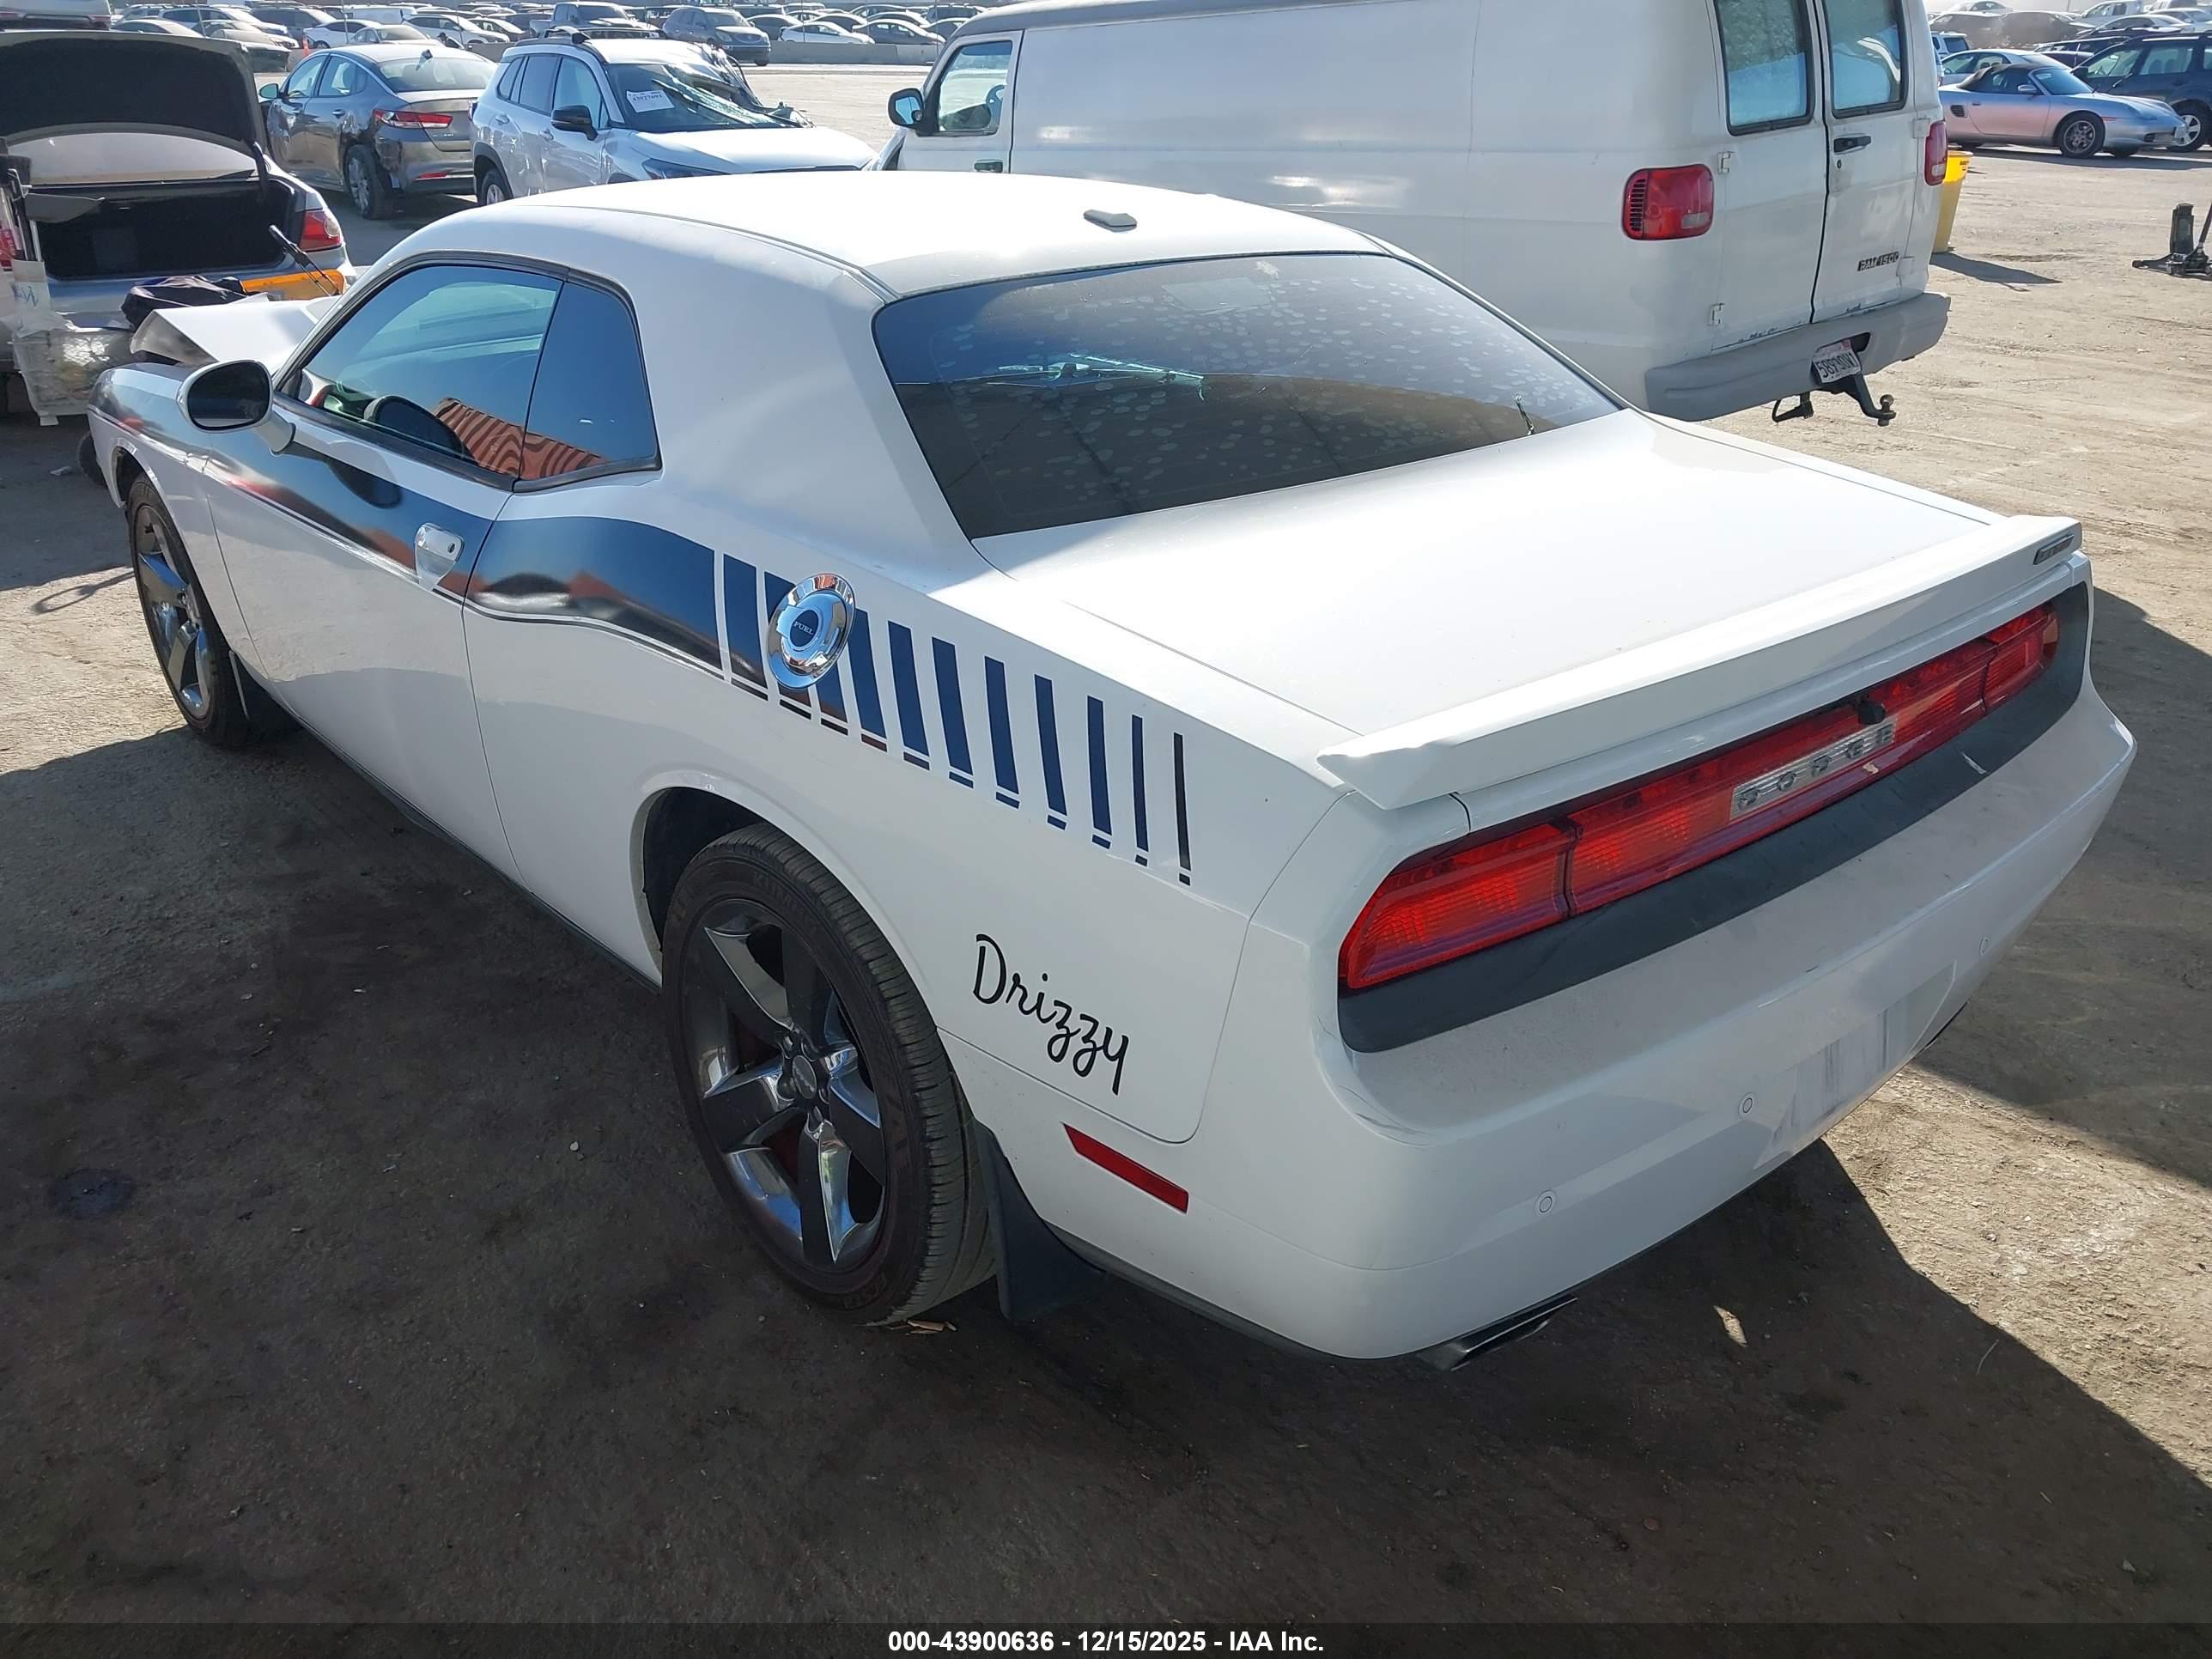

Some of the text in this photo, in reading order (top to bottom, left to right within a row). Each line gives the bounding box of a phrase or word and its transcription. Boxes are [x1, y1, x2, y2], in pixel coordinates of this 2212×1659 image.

[793, 621, 814, 635] FUEL
[1738, 724, 1893, 811] DODGE
[973, 933, 1129, 1096] Drizzy
